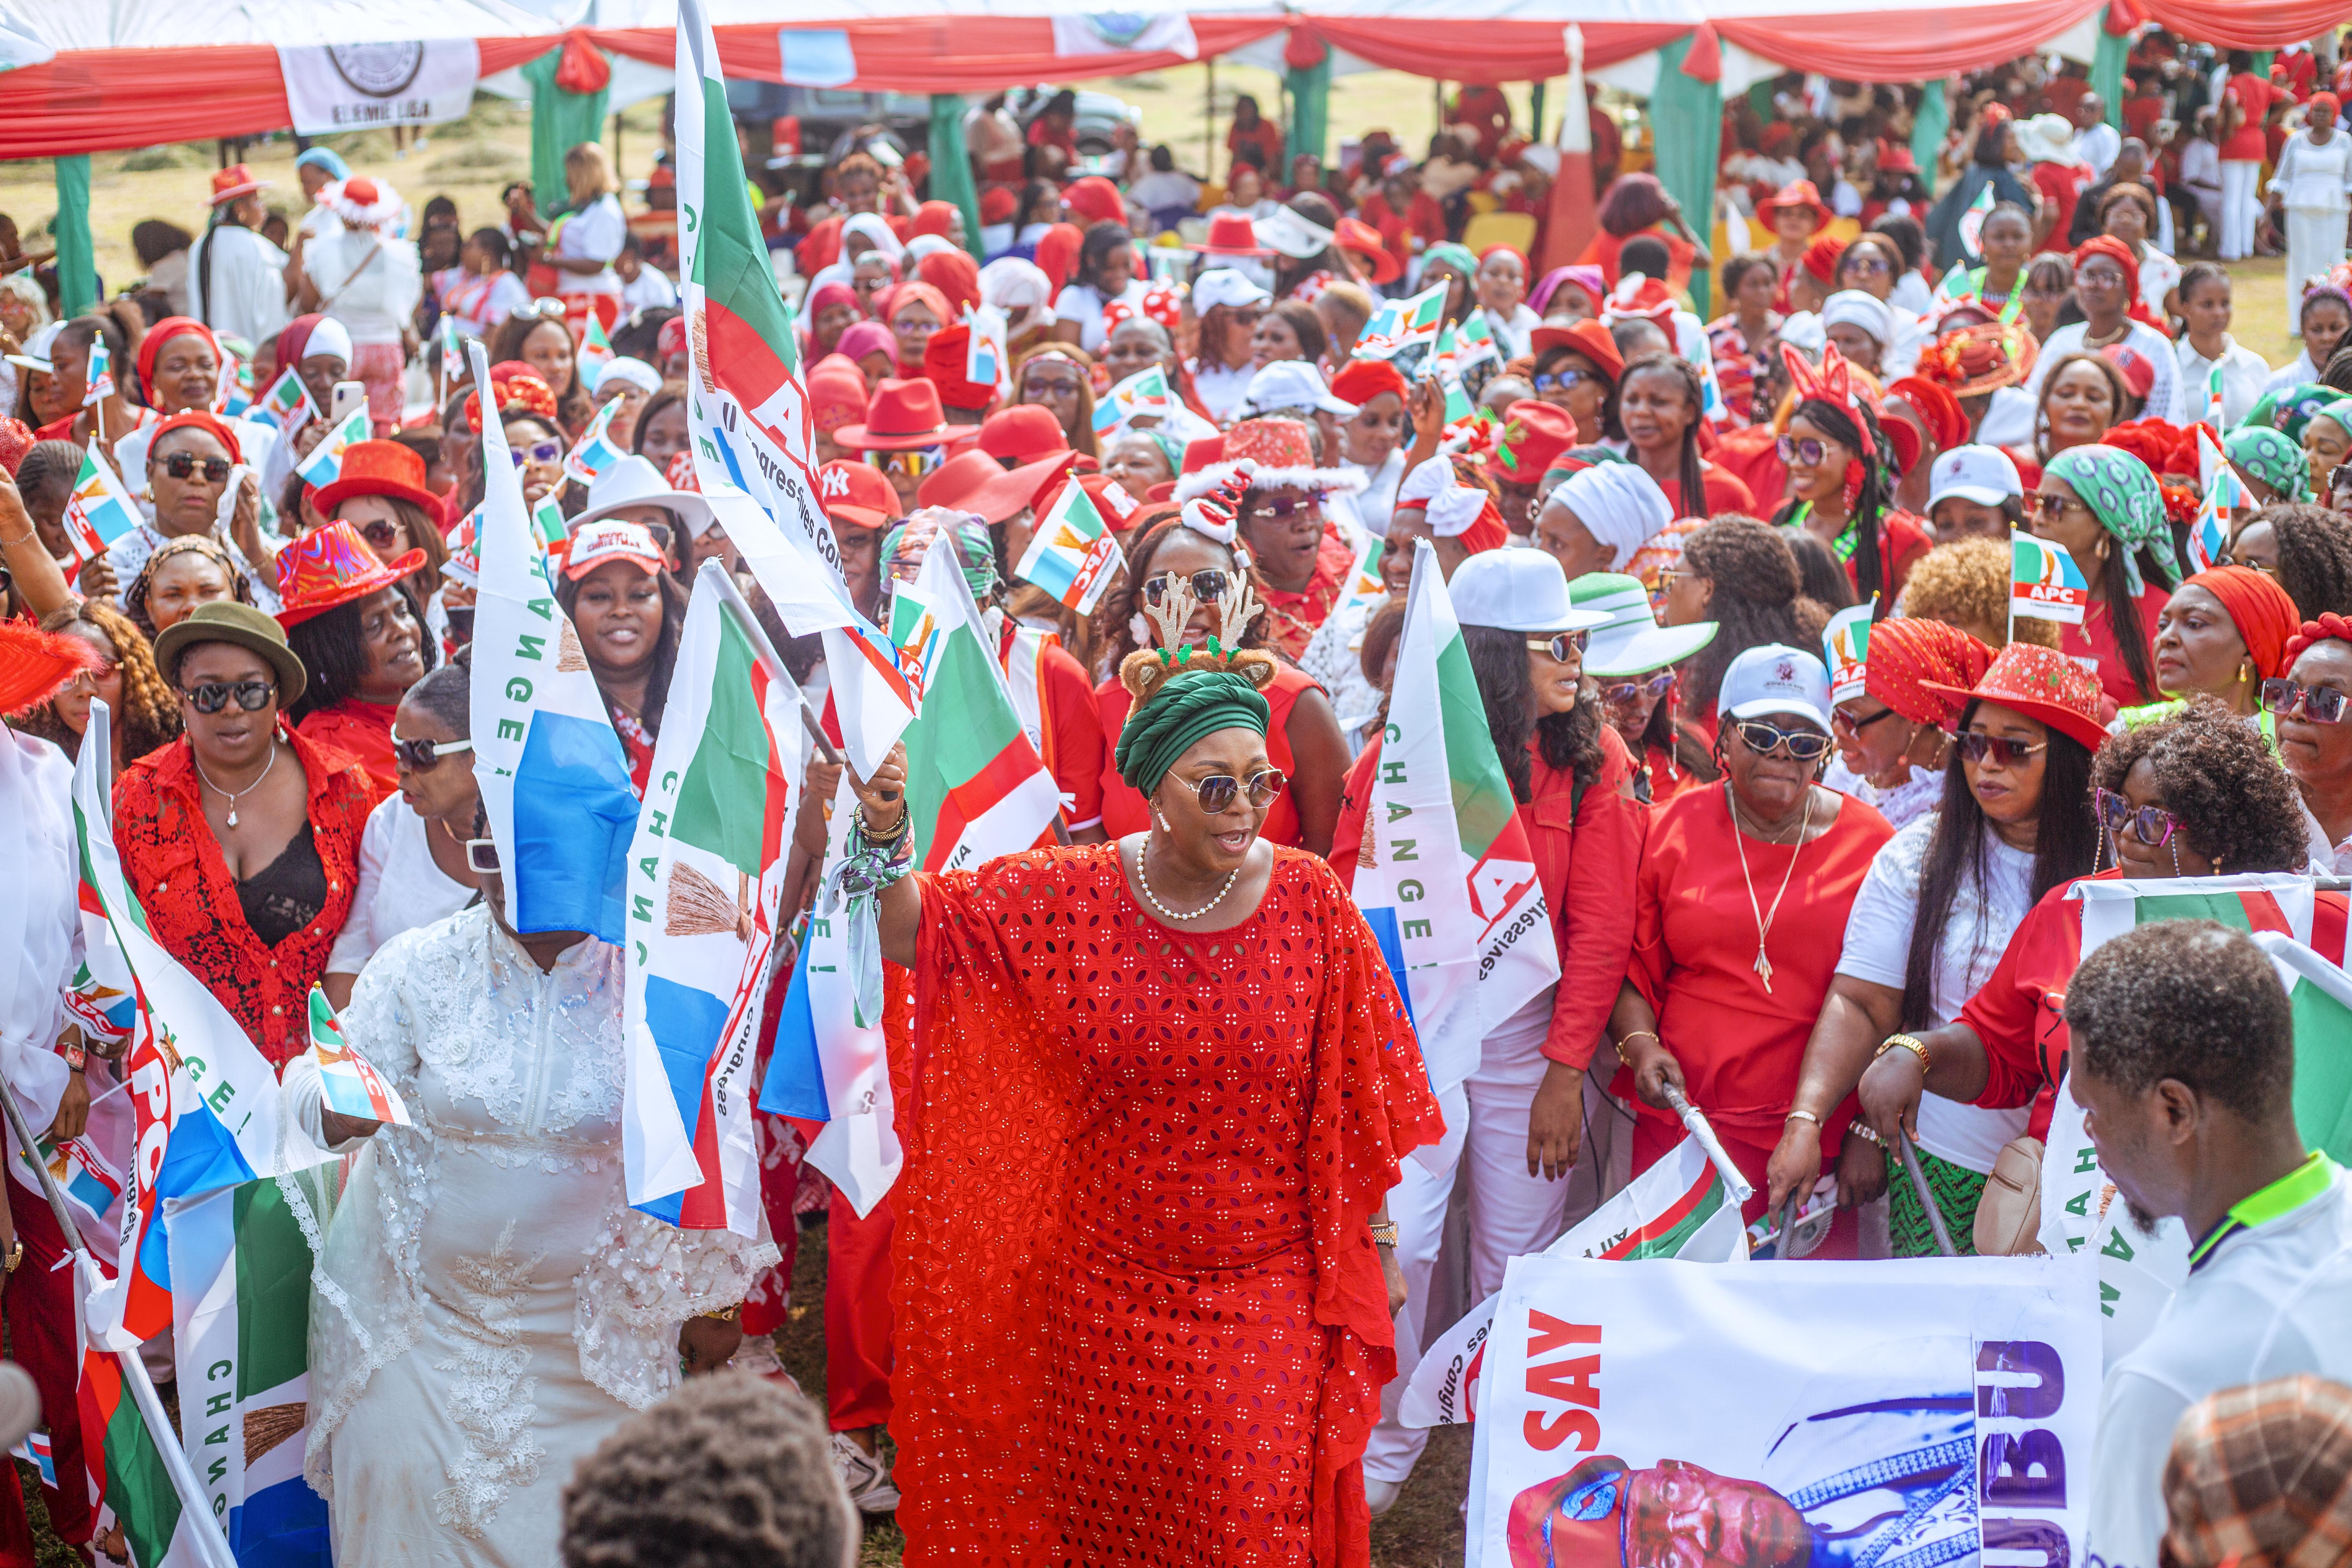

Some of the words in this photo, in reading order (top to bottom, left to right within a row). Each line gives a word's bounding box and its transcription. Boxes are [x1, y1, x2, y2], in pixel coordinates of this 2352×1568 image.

[822, 467, 850, 496] NY
[587, 538, 641, 552] CHRISTMAS
[598, 532, 628, 541] MERRY
[2030, 586, 2074, 604] APC
[1438, 1354, 1463, 1425] Congre
[1523, 1308, 1602, 1452] SAY
